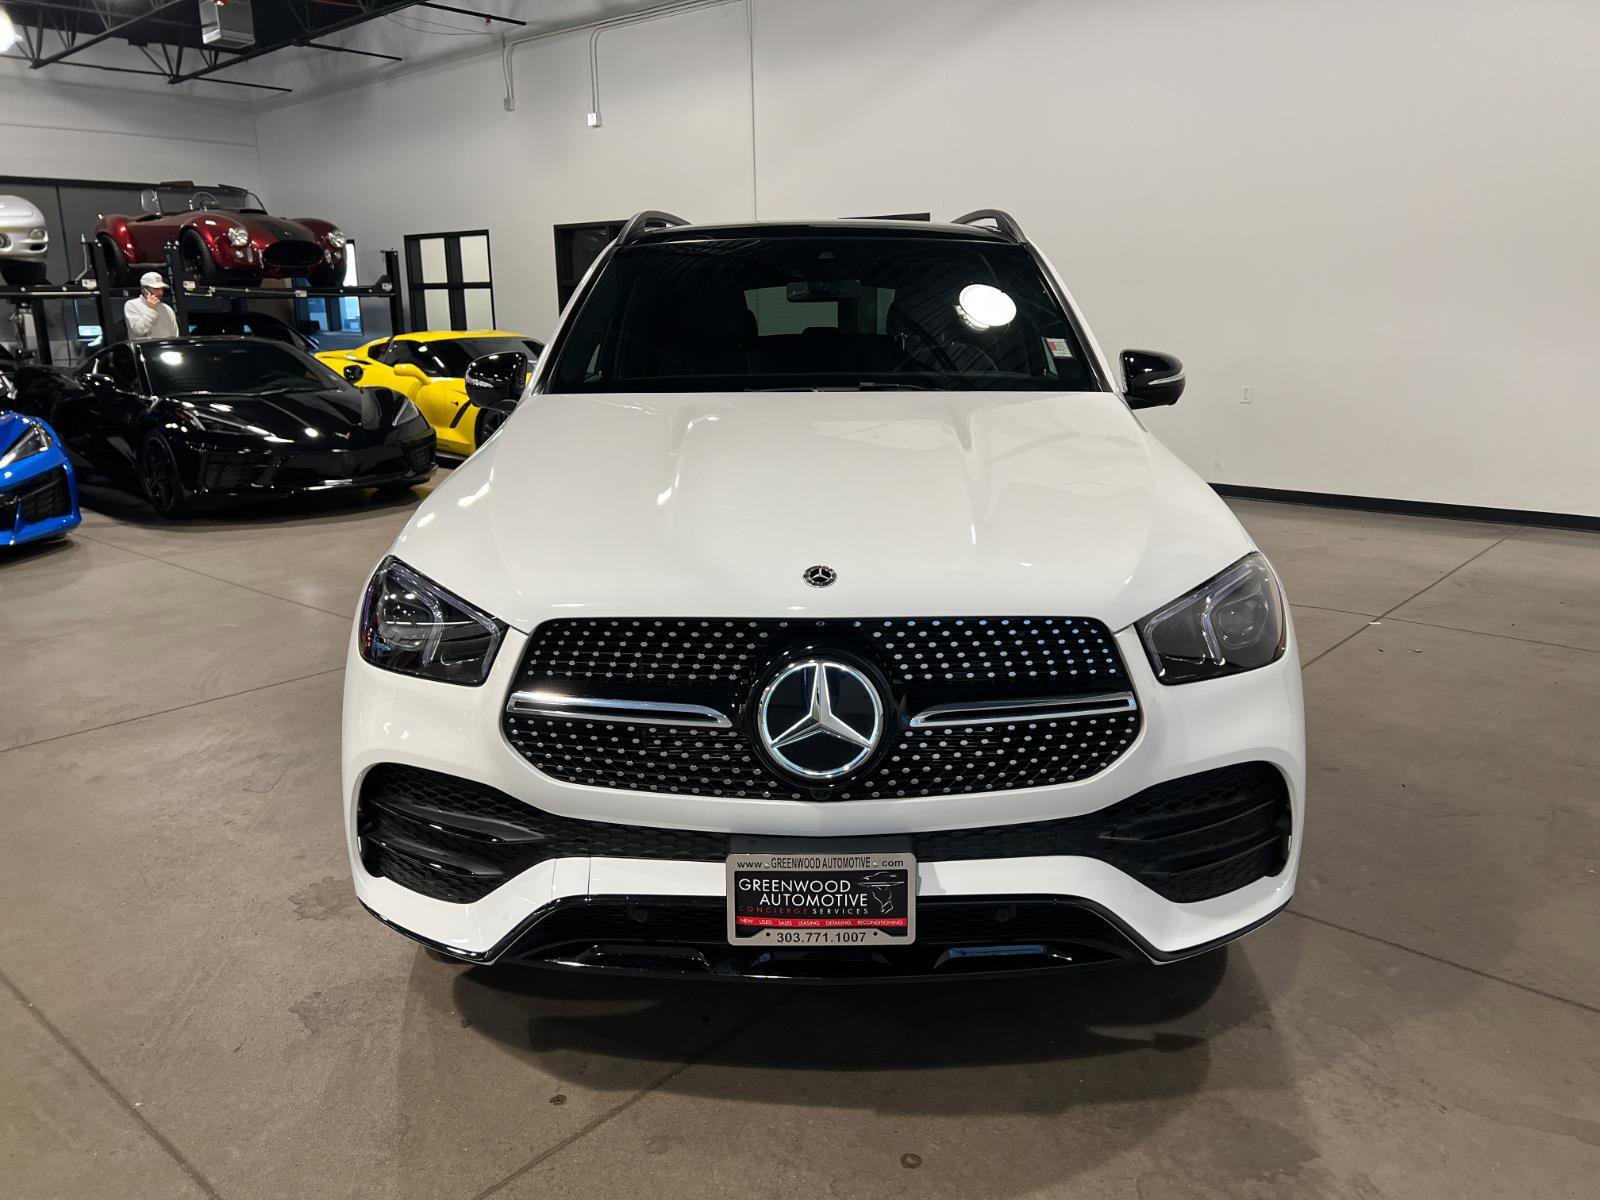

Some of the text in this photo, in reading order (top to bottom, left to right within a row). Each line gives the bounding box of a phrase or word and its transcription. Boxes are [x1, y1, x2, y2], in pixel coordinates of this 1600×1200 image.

[736, 861, 763, 869] www
[771, 857, 821, 869] GREENWOOD
[822, 856, 871, 869] AUTOMOTIVE
[738, 878, 851, 893] GREENWOOD
[759, 893, 868, 907] AUTOMOTIVE
[776, 931, 867, 943] 303.771.1007
